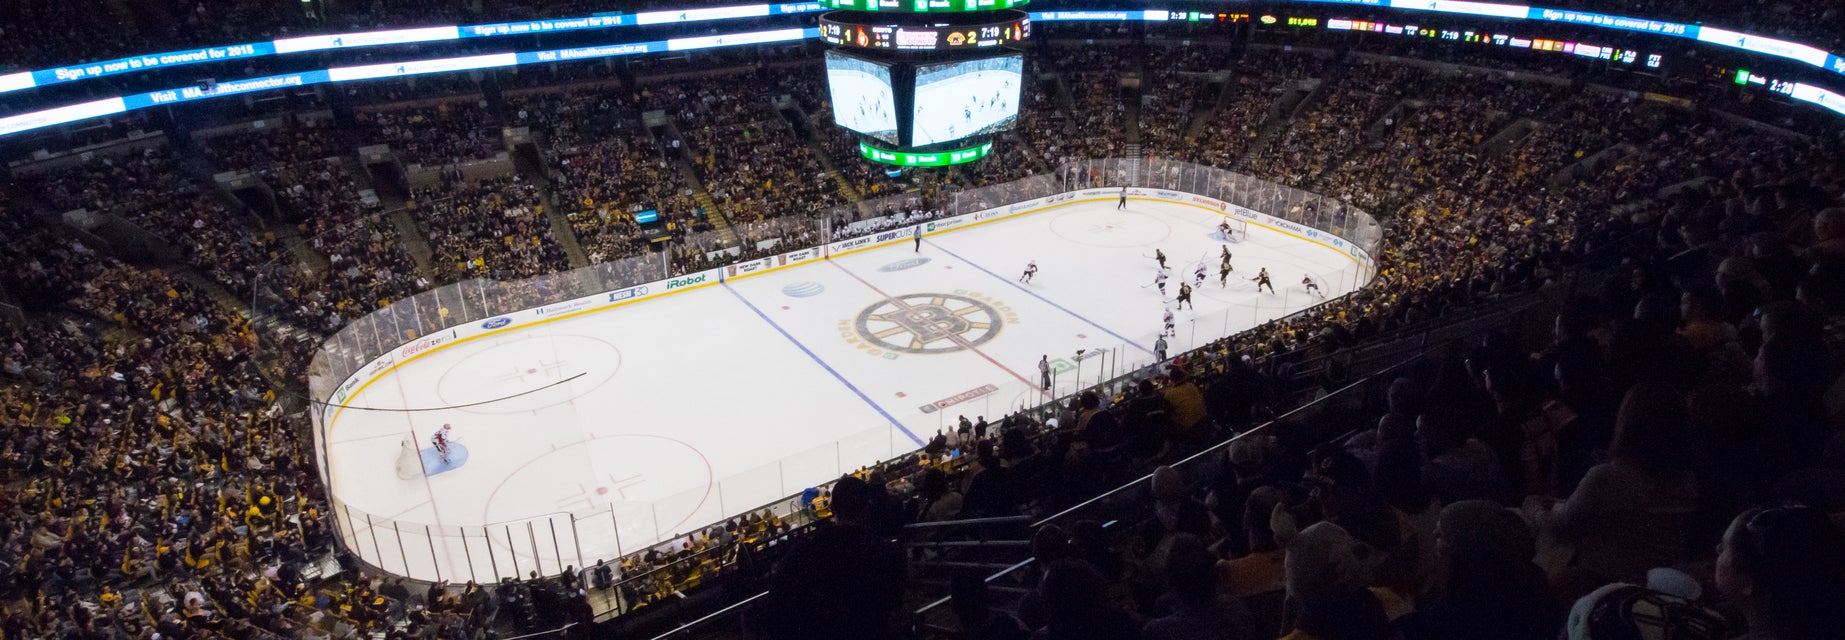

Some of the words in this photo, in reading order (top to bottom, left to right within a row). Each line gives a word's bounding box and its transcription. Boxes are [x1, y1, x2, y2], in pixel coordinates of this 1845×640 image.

[781, 5, 796, 13] Sign
[475, 25, 497, 36] Sign
[498, 26, 509, 34] up
[531, 23, 541, 31] to
[542, 21, 553, 30] be
[554, 19, 588, 29] covered
[589, 18, 602, 27] for
[602, 16, 622, 26] 2015
[1543, 9, 1563, 21] Sign
[1564, 12, 1577, 22] up
[1576, 14, 1592, 23] now
[1593, 16, 1602, 24] to
[1603, 16, 1614, 25] be
[1615, 18, 1648, 30] covered
[1649, 22, 1662, 31] for
[1663, 23, 1685, 34] 2015
[845, 29, 851, 41] 1
[967, 30, 977, 44] 2
[981, 26, 999, 38] 7:19
[1004, 27, 1011, 39] 1
[1442, 30, 1459, 39] 7:19
[538, 51, 556, 61] Visit
[560, 44, 648, 59] MAhealthconnector.org
[55, 68, 85, 80] Sign
[86, 66, 102, 76] up
[104, 61, 128, 72] now
[129, 58, 142, 68] to
[142, 57, 158, 66] be
[160, 48, 208, 64] covered
[208, 48, 226, 58] for
[227, 44, 254, 56] 2015
[150, 90, 178, 103] Visit
[1234, 208, 1258, 220] jetBlue
[876, 227, 913, 243] SUPERCUTS
[666, 273, 706, 290] iRobot
[486, 320, 507, 329] Ford
